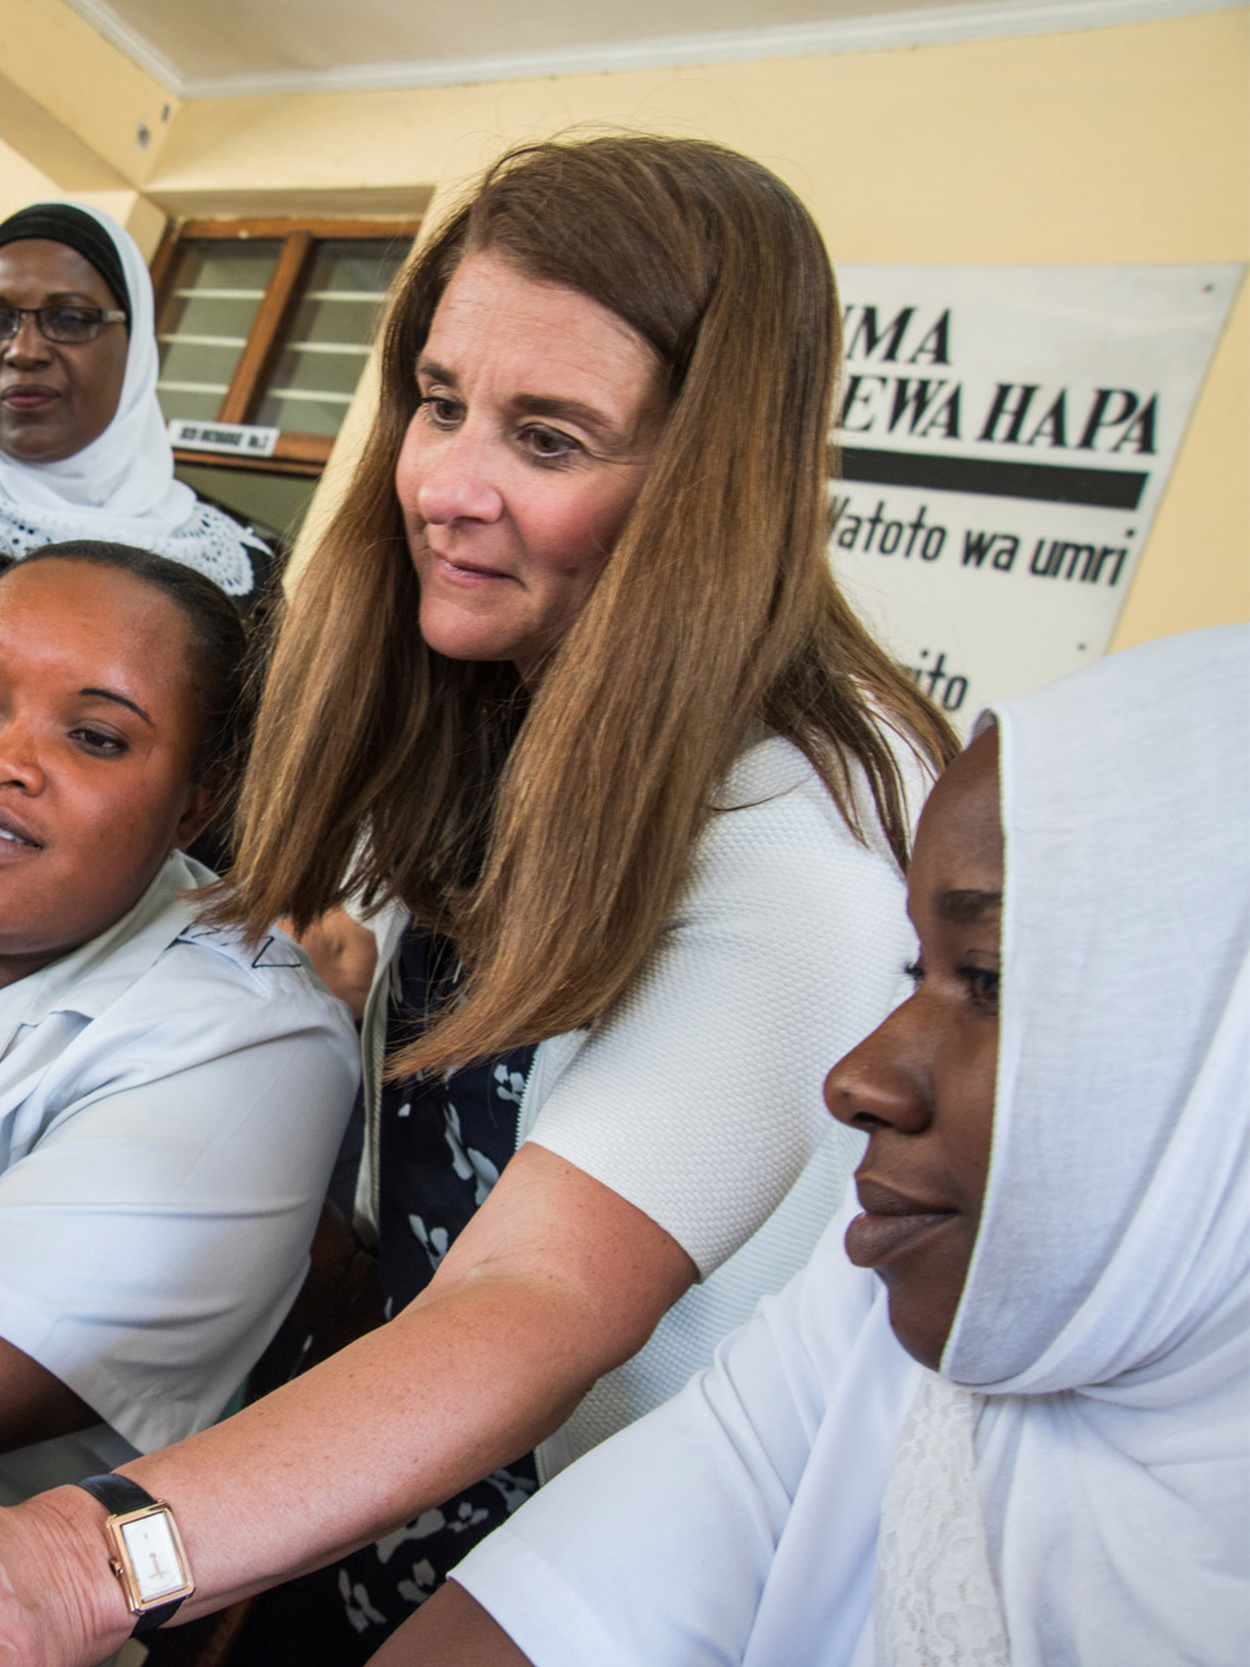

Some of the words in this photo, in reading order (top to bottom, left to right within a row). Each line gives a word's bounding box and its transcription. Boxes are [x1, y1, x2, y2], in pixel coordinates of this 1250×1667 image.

[843, 305, 952, 366] MA
[975, 383, 1158, 455] HAPA
[961, 529, 1020, 573] wa
[1029, 528, 1136, 587] umri
[905, 650, 969, 712] ito
